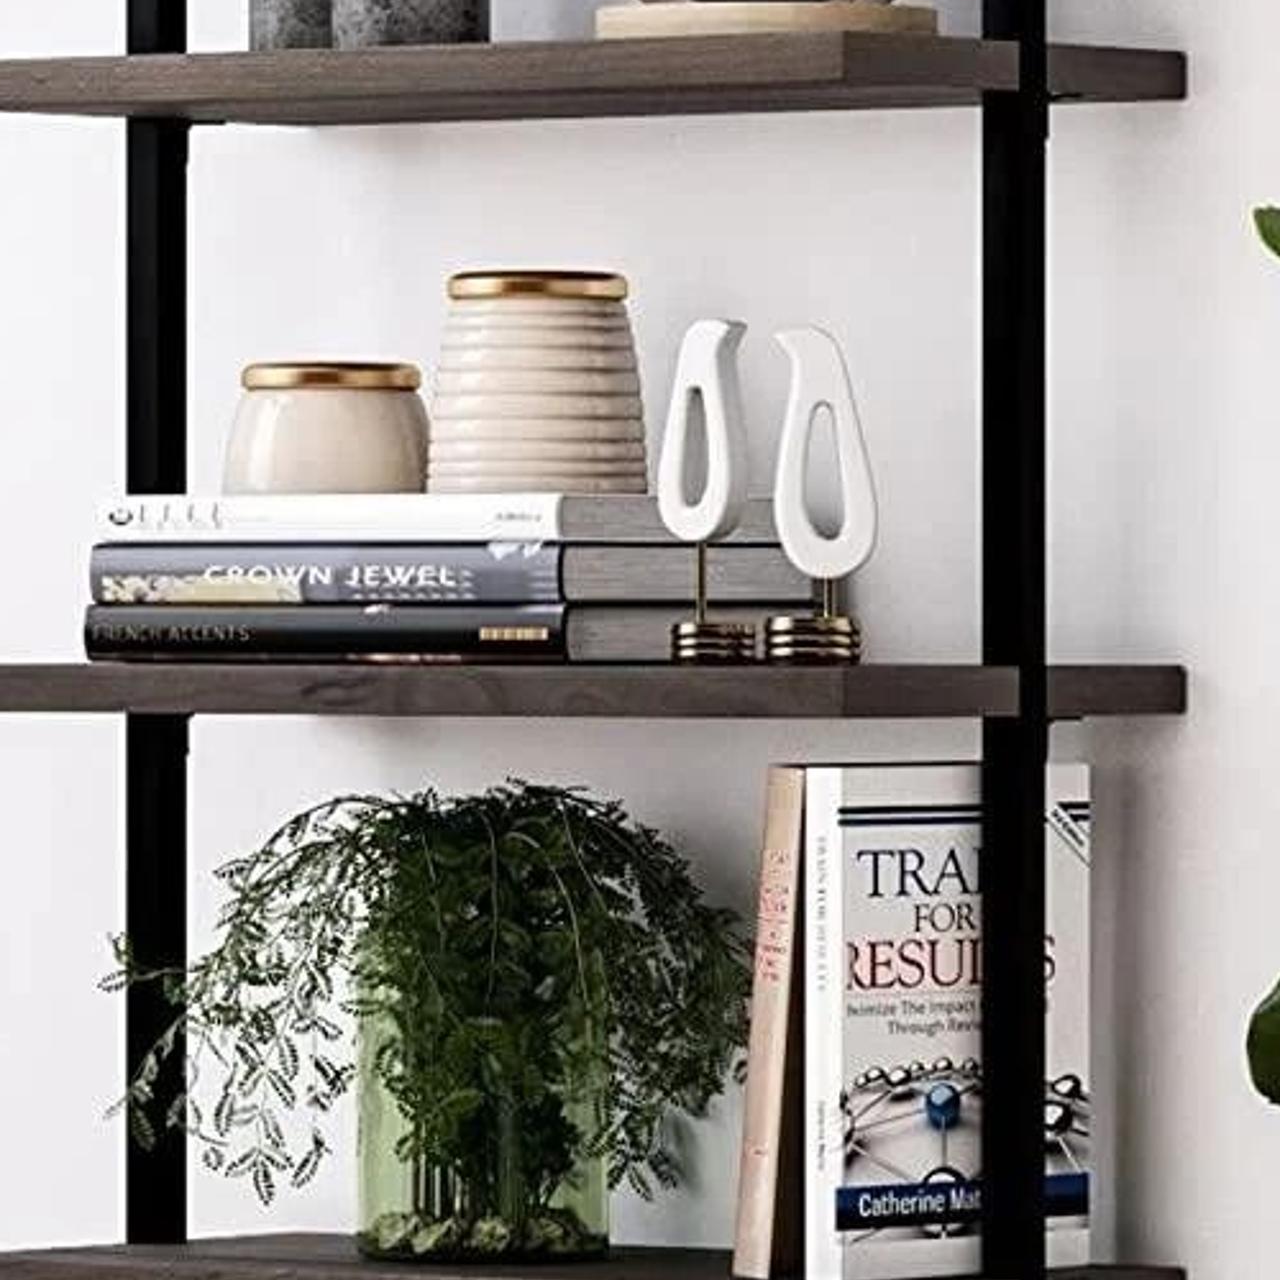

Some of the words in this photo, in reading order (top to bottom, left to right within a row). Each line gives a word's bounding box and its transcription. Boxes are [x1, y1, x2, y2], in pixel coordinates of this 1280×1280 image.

[202, 564, 333, 587] CROWN
[913, 903, 977, 932] FOR
[858, 1189, 947, 1218] Catherine
[949, 1188, 982, 1211] Mat
